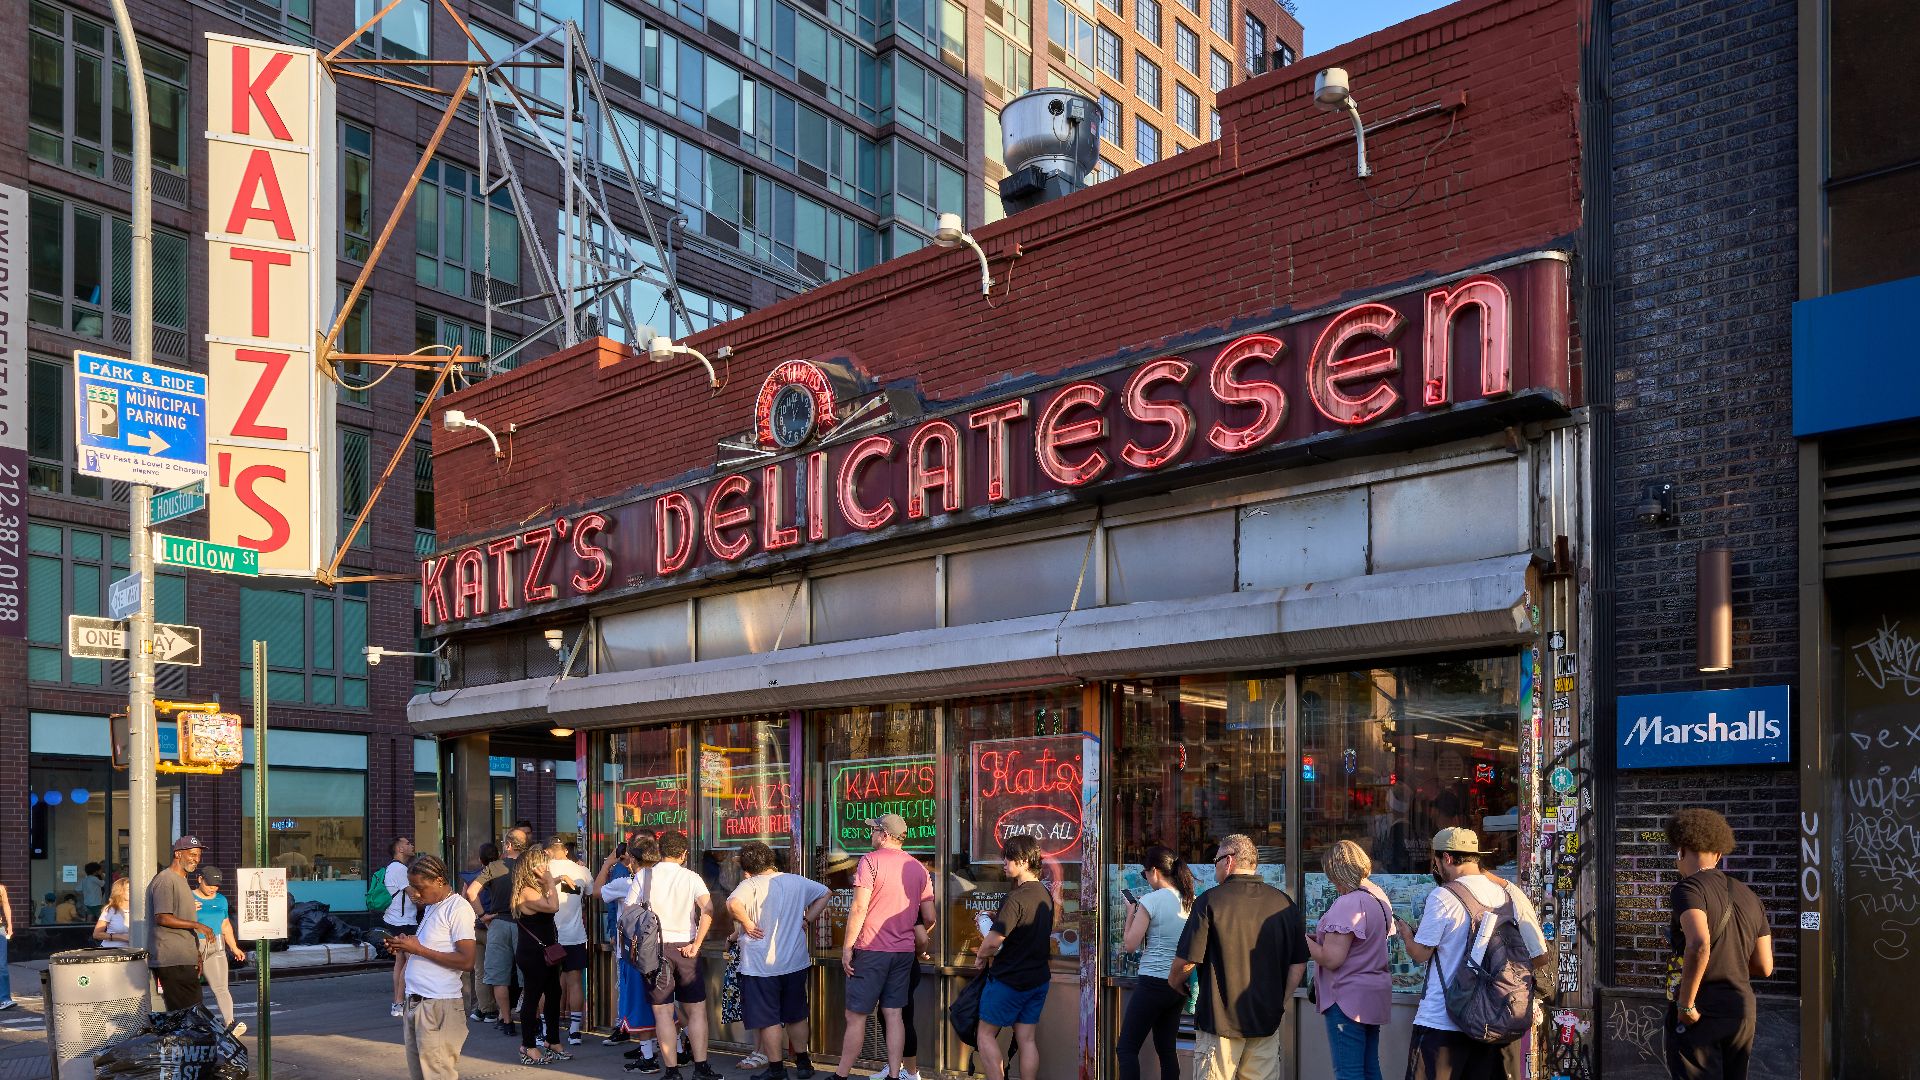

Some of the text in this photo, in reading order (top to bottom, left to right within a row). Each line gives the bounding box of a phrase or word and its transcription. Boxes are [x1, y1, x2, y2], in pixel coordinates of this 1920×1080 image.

[218, 46, 296, 553] KATZ'S
[90, 361, 195, 392] PARK & RIDE
[90, 401, 116, 435] P
[126, 390, 200, 417] MUNICIPAL
[126, 408, 187, 430] PARKING
[157, 491, 194, 518] Houston
[162, 539, 255, 569] Ludlow St
[422, 512, 613, 625] KATZ'S
[86, 630, 176, 651] ONE AY
[1624, 710, 1781, 746] Marshalls
[734, 781, 791, 811] KATZ'S
[846, 766, 935, 800] KATZ'S
[726, 814, 791, 835] FRANKFURTE
[842, 828, 862, 839] BEST
[1049, 822, 1074, 840] ALL
[1802, 811, 1820, 901] UNO
